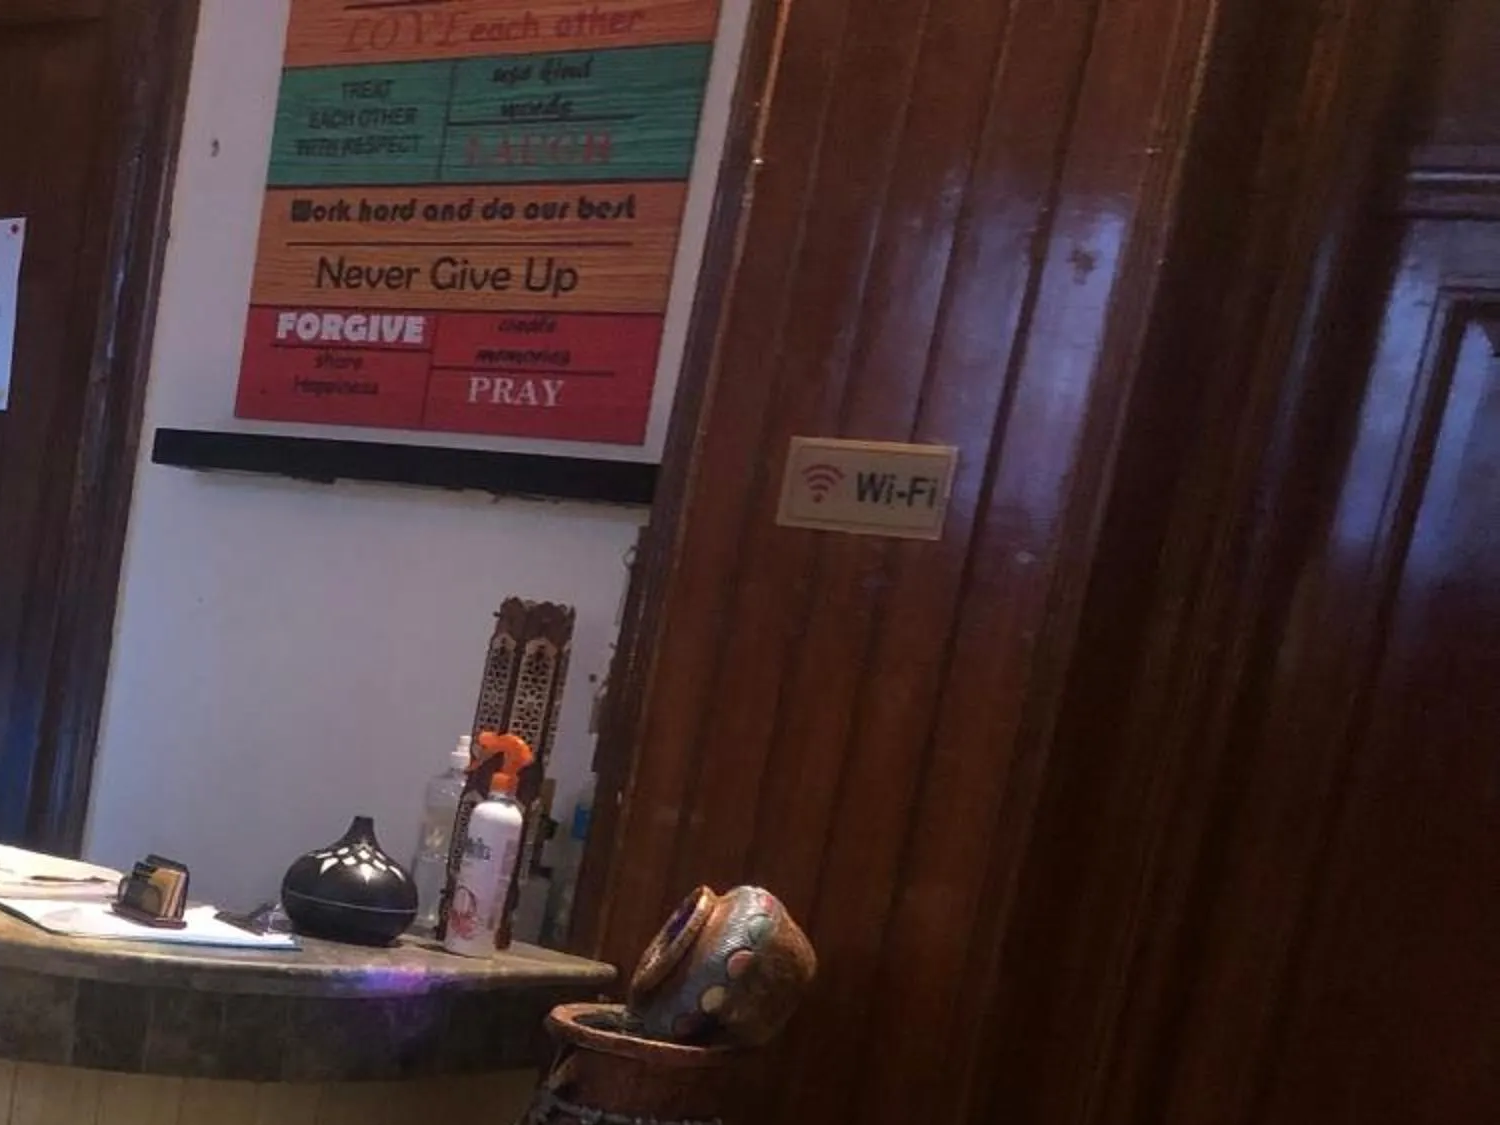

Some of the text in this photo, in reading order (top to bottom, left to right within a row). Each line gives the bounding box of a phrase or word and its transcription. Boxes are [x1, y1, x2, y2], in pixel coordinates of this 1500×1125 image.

[470, 11, 540, 42] each
[555, 6, 646, 37] other
[341, 79, 395, 99] TREAT
[308, 106, 418, 129] EACH OTHER
[345, 134, 424, 155] RESPECT
[290, 196, 636, 224] Work hard and do our best
[315, 256, 579, 297] Never Give Up
[276, 312, 426, 344] FORGIVE
[467, 376, 565, 407] PRAY
[856, 471, 939, 508] Wi-Fi
